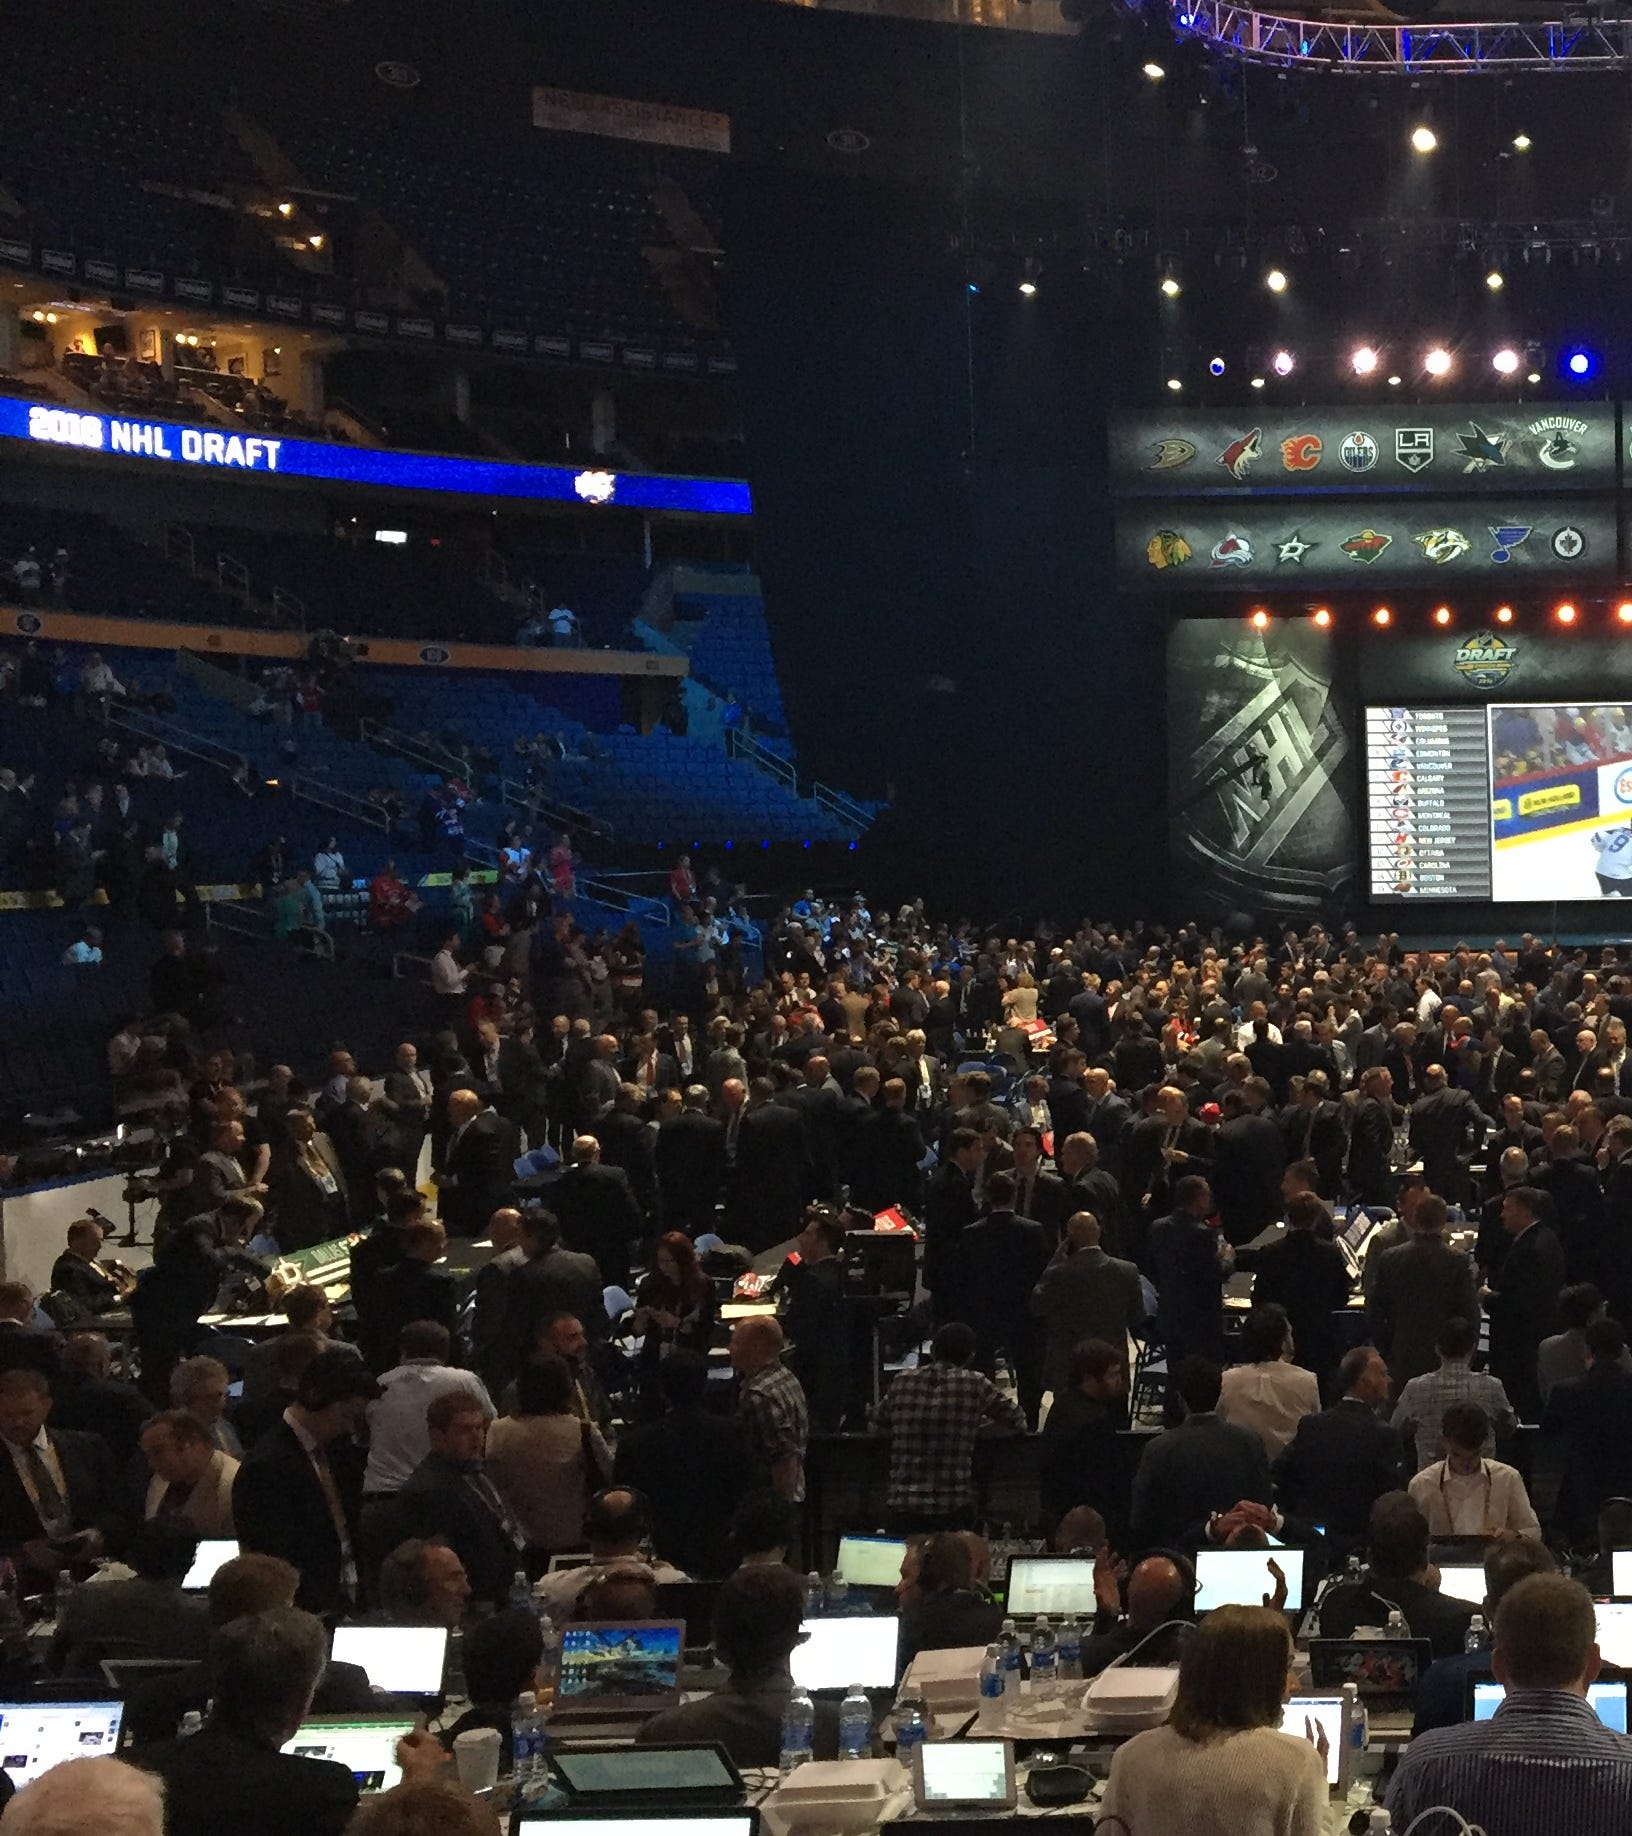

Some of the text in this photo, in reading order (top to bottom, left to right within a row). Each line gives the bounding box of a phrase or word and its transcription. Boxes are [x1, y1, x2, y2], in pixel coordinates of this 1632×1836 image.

[1528, 416, 1588, 435] VANCOUVER
[111, 420, 171, 459] NHL
[181, 429, 281, 470] DRAFT
[1399, 433, 1430, 447] LA
[1456, 647, 1517, 661] DRAFT
[1608, 834, 1630, 853] 9
